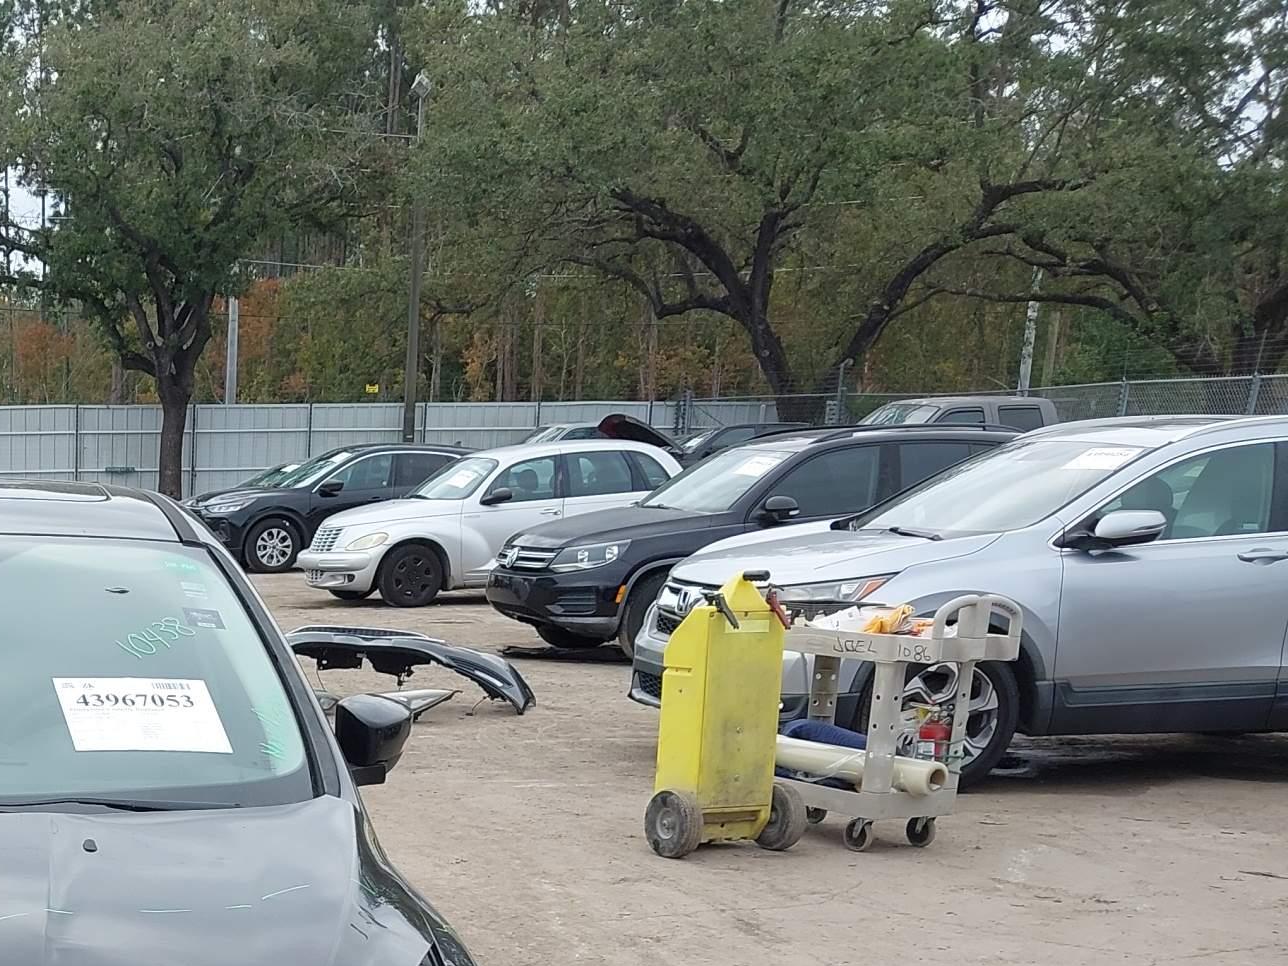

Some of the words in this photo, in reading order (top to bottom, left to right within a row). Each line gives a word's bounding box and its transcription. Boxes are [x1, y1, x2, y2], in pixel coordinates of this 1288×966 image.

[115, 616, 196, 659] 10438
[833, 637, 878, 654] JOEL
[76, 693, 195, 708] 43967053
